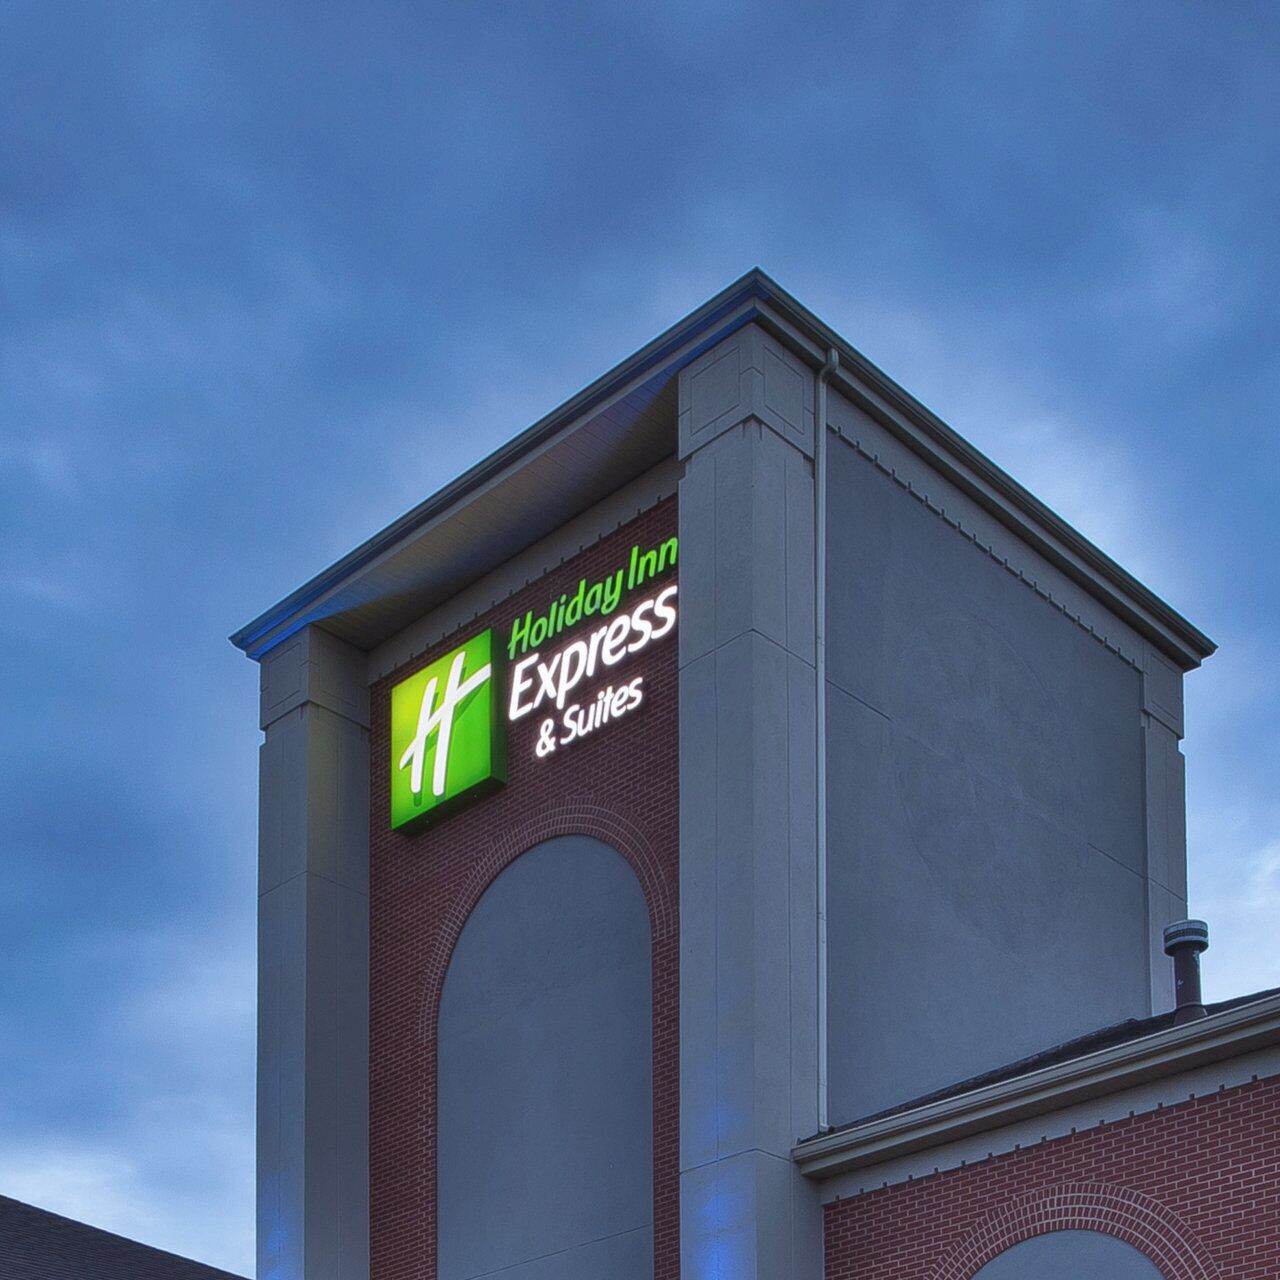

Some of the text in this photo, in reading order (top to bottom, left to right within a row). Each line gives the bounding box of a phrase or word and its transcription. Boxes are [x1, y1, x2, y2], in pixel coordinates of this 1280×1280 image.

[507, 536, 678, 660] Holiday Inn
[508, 585, 678, 721] Express
[536, 677, 644, 758] & Suites
